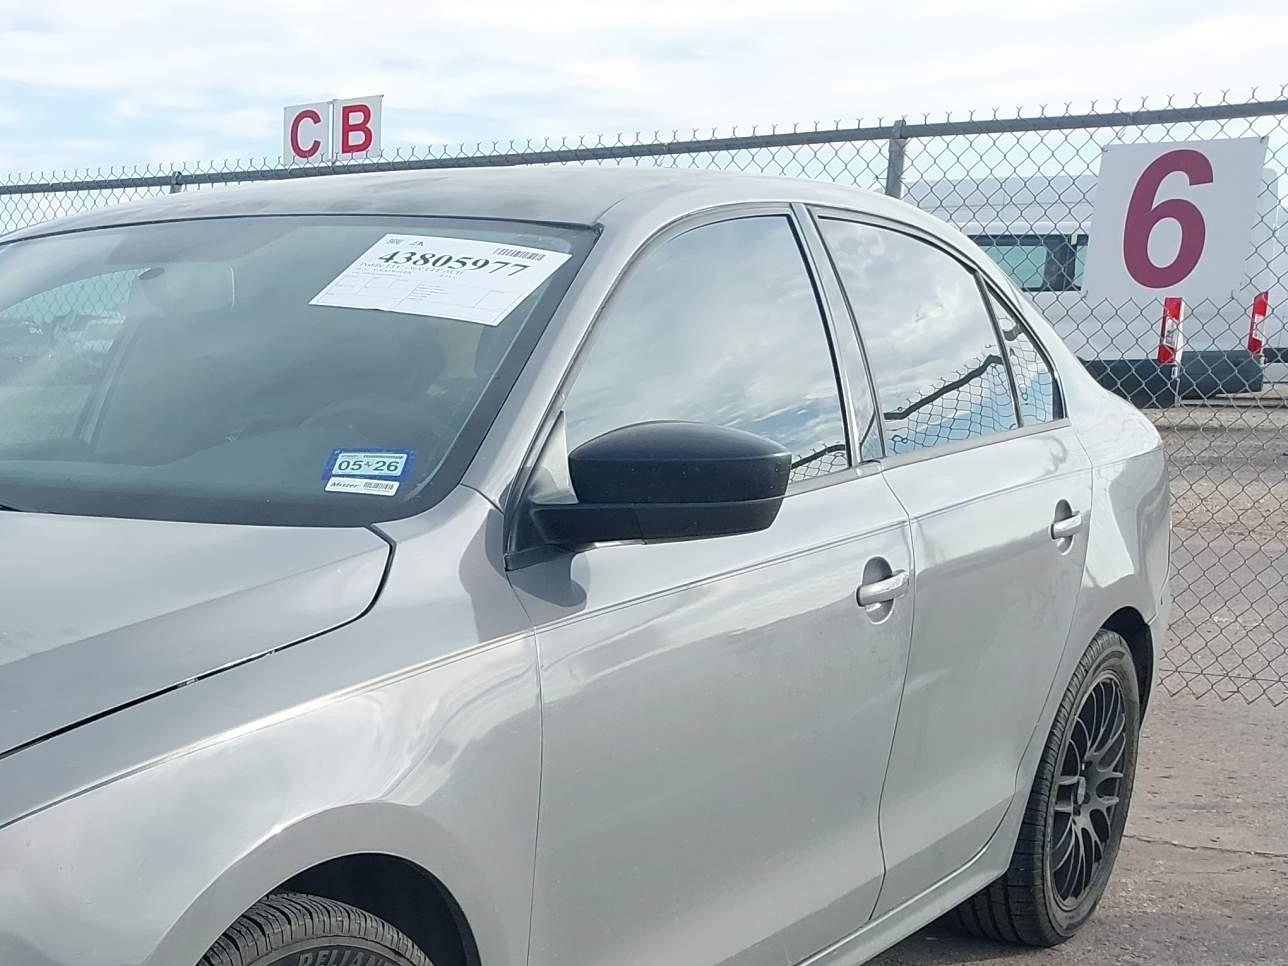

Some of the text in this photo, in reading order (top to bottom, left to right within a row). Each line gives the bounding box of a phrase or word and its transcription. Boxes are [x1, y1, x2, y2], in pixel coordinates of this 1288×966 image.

[290, 103, 373, 159] C B
[1122, 148, 1215, 290] 6
[377, 248, 531, 278] 43805977
[337, 459, 401, 473] 05 26
